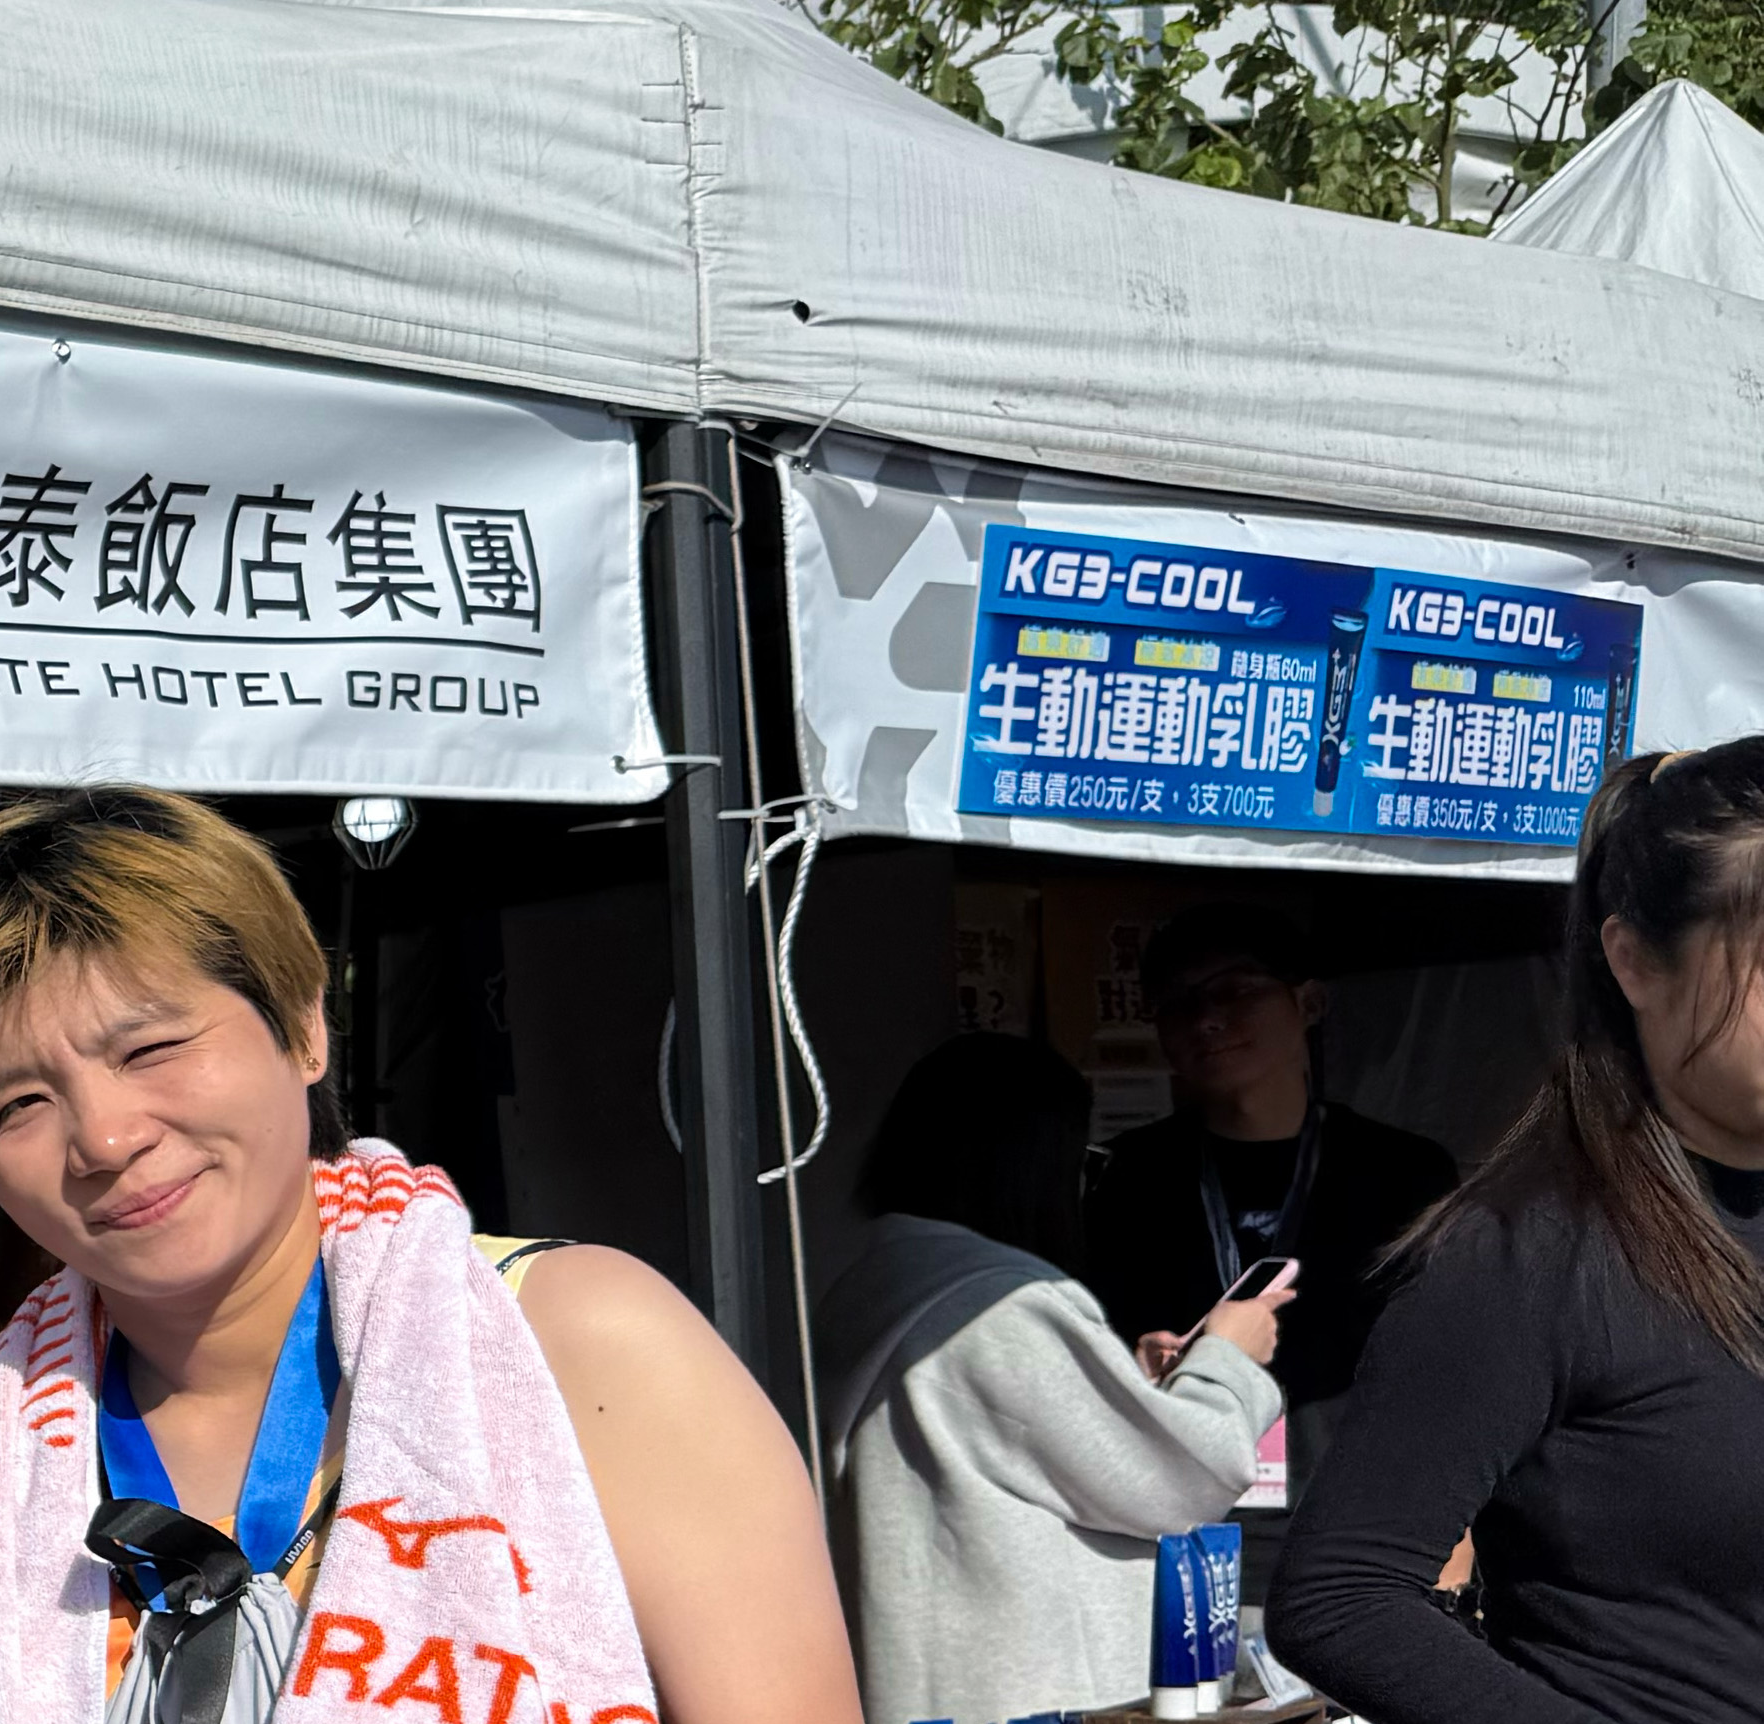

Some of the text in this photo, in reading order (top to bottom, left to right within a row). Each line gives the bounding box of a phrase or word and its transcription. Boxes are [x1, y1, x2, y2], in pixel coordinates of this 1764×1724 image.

[1004, 546, 1257, 616] KG3-COOL
[1387, 587, 1565, 650] KG3-COOL
[104, 662, 323, 708] HOTEL
[344, 669, 541, 720] GROUP
[973, 662, 1317, 774] 生動運動乳膠
[1364, 694, 1604, 794] 生動運動乳膠
